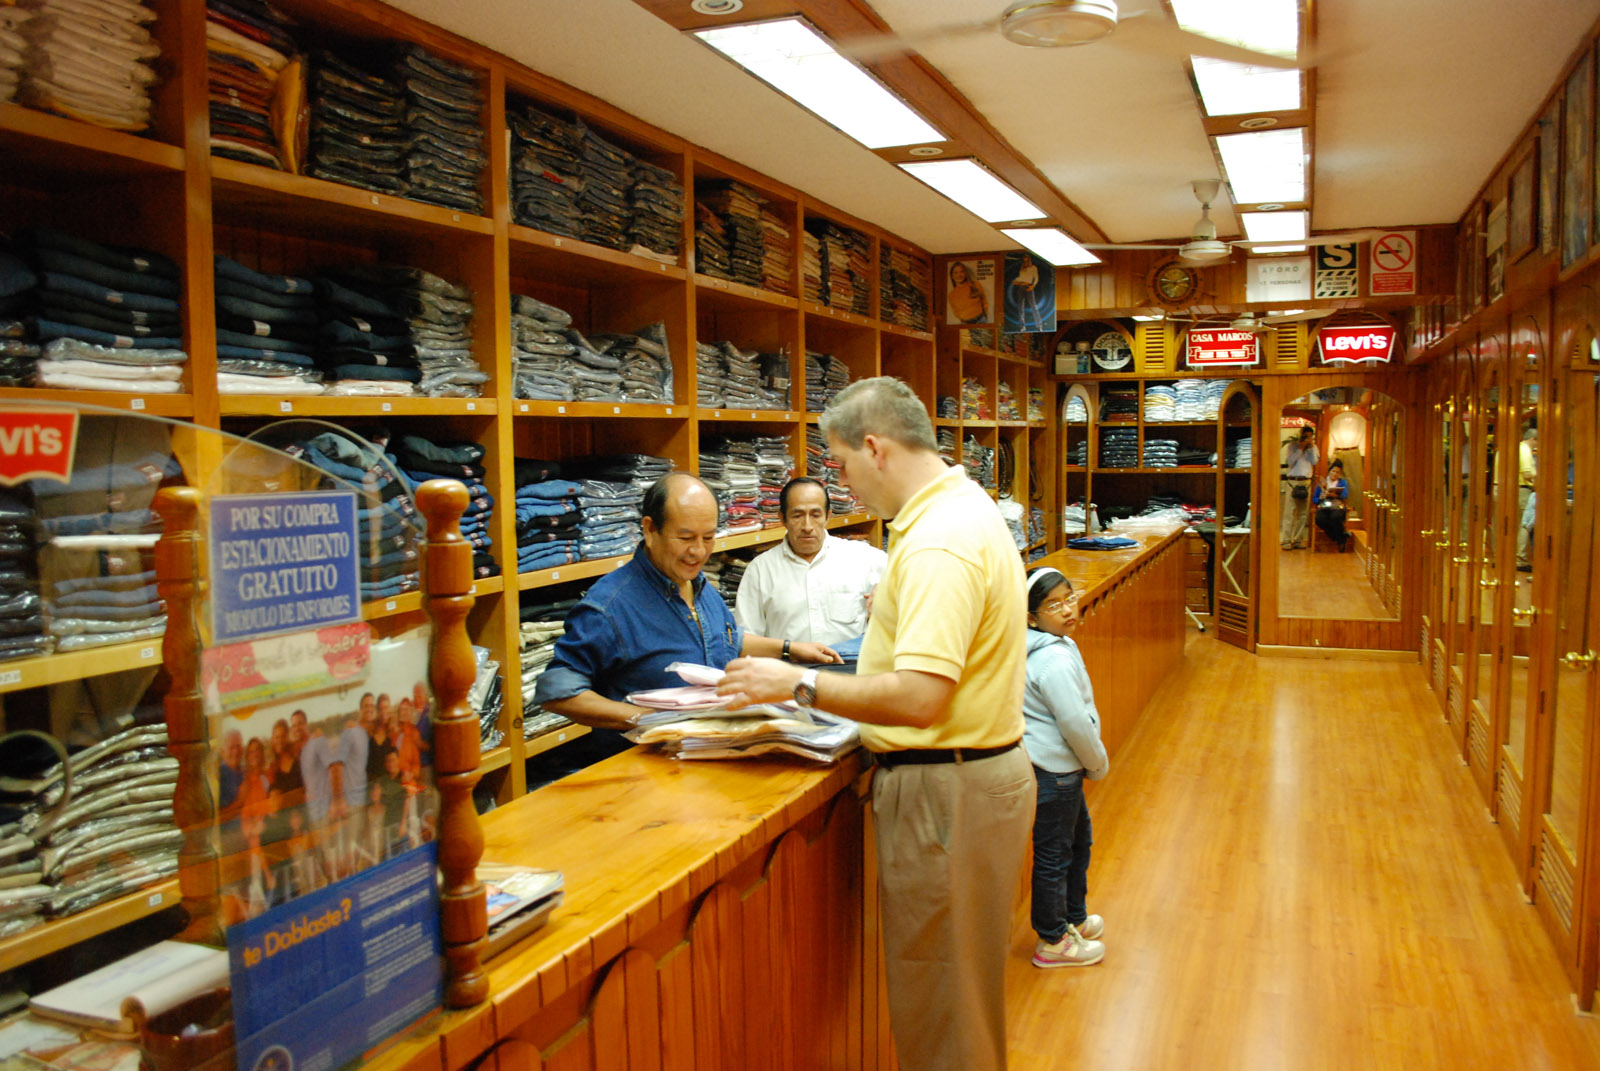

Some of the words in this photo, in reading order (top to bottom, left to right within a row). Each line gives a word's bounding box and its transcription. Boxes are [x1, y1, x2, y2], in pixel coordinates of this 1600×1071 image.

[1323, 243, 1352, 267] S
[1190, 333, 1214, 343] CASA
[1217, 331, 1254, 342] MARCOS
[230, 504, 261, 531] POR
[262, 504, 282, 529] SU
[284, 503, 340, 529] COMPRA
[220, 531, 350, 570] ESTACIONAMIENTO
[238, 563, 339, 601] GRATUITO
[224, 605, 278, 633] MODULO
[279, 602, 296, 625] DE
[296, 594, 351, 622] INFORMES
[242, 945, 262, 967] te
[265, 897, 352, 958] Doblaste?
